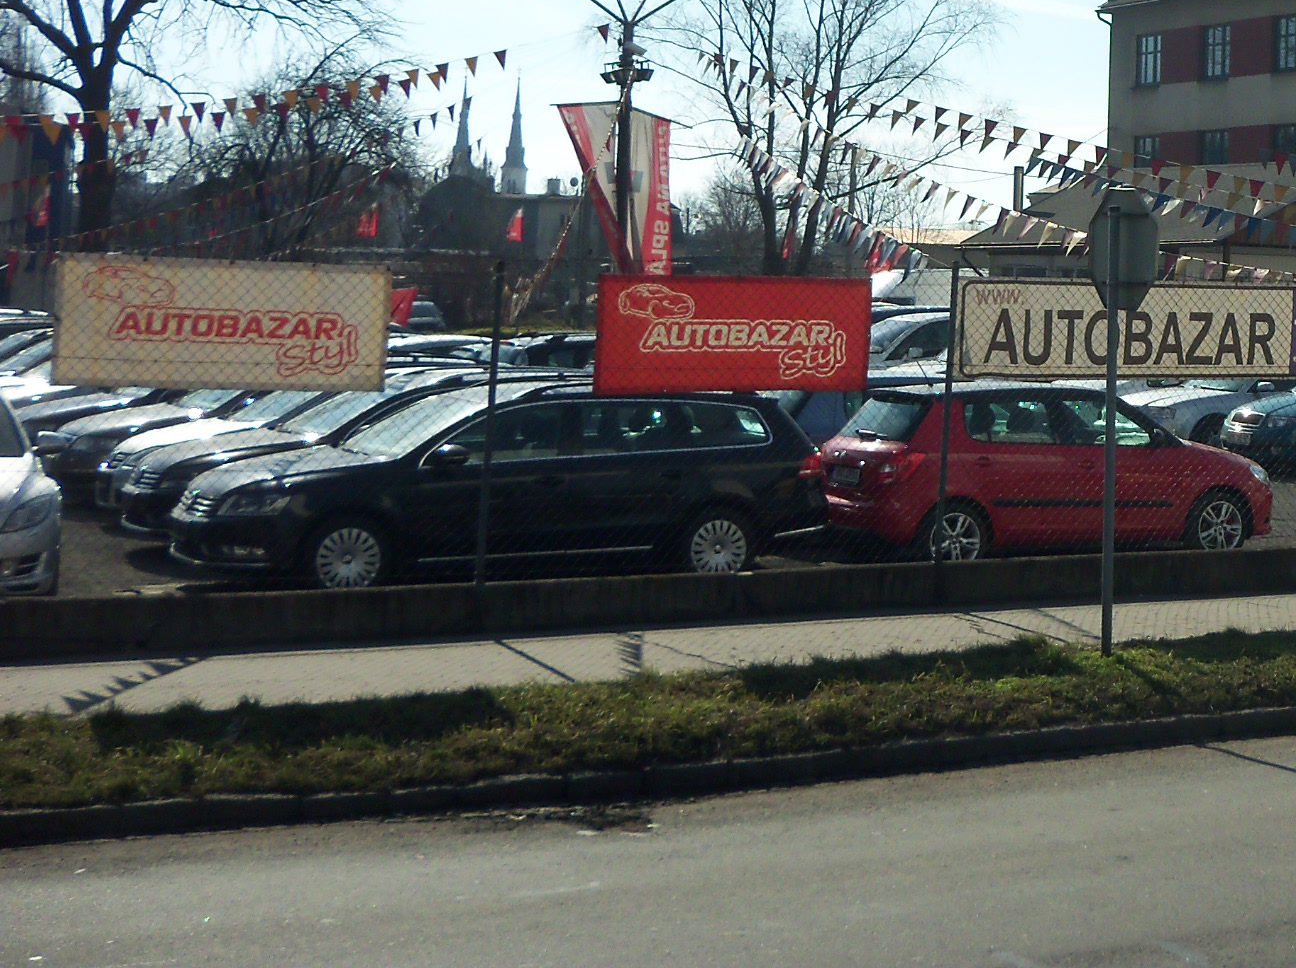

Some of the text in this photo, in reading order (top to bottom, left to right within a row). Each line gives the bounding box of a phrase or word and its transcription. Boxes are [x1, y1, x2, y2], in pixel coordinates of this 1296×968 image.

[114, 311, 340, 341] AUTOBAZAR
[645, 322, 831, 347] AUTOBAZAR
[984, 307, 1276, 366] AUTOBAZAR
